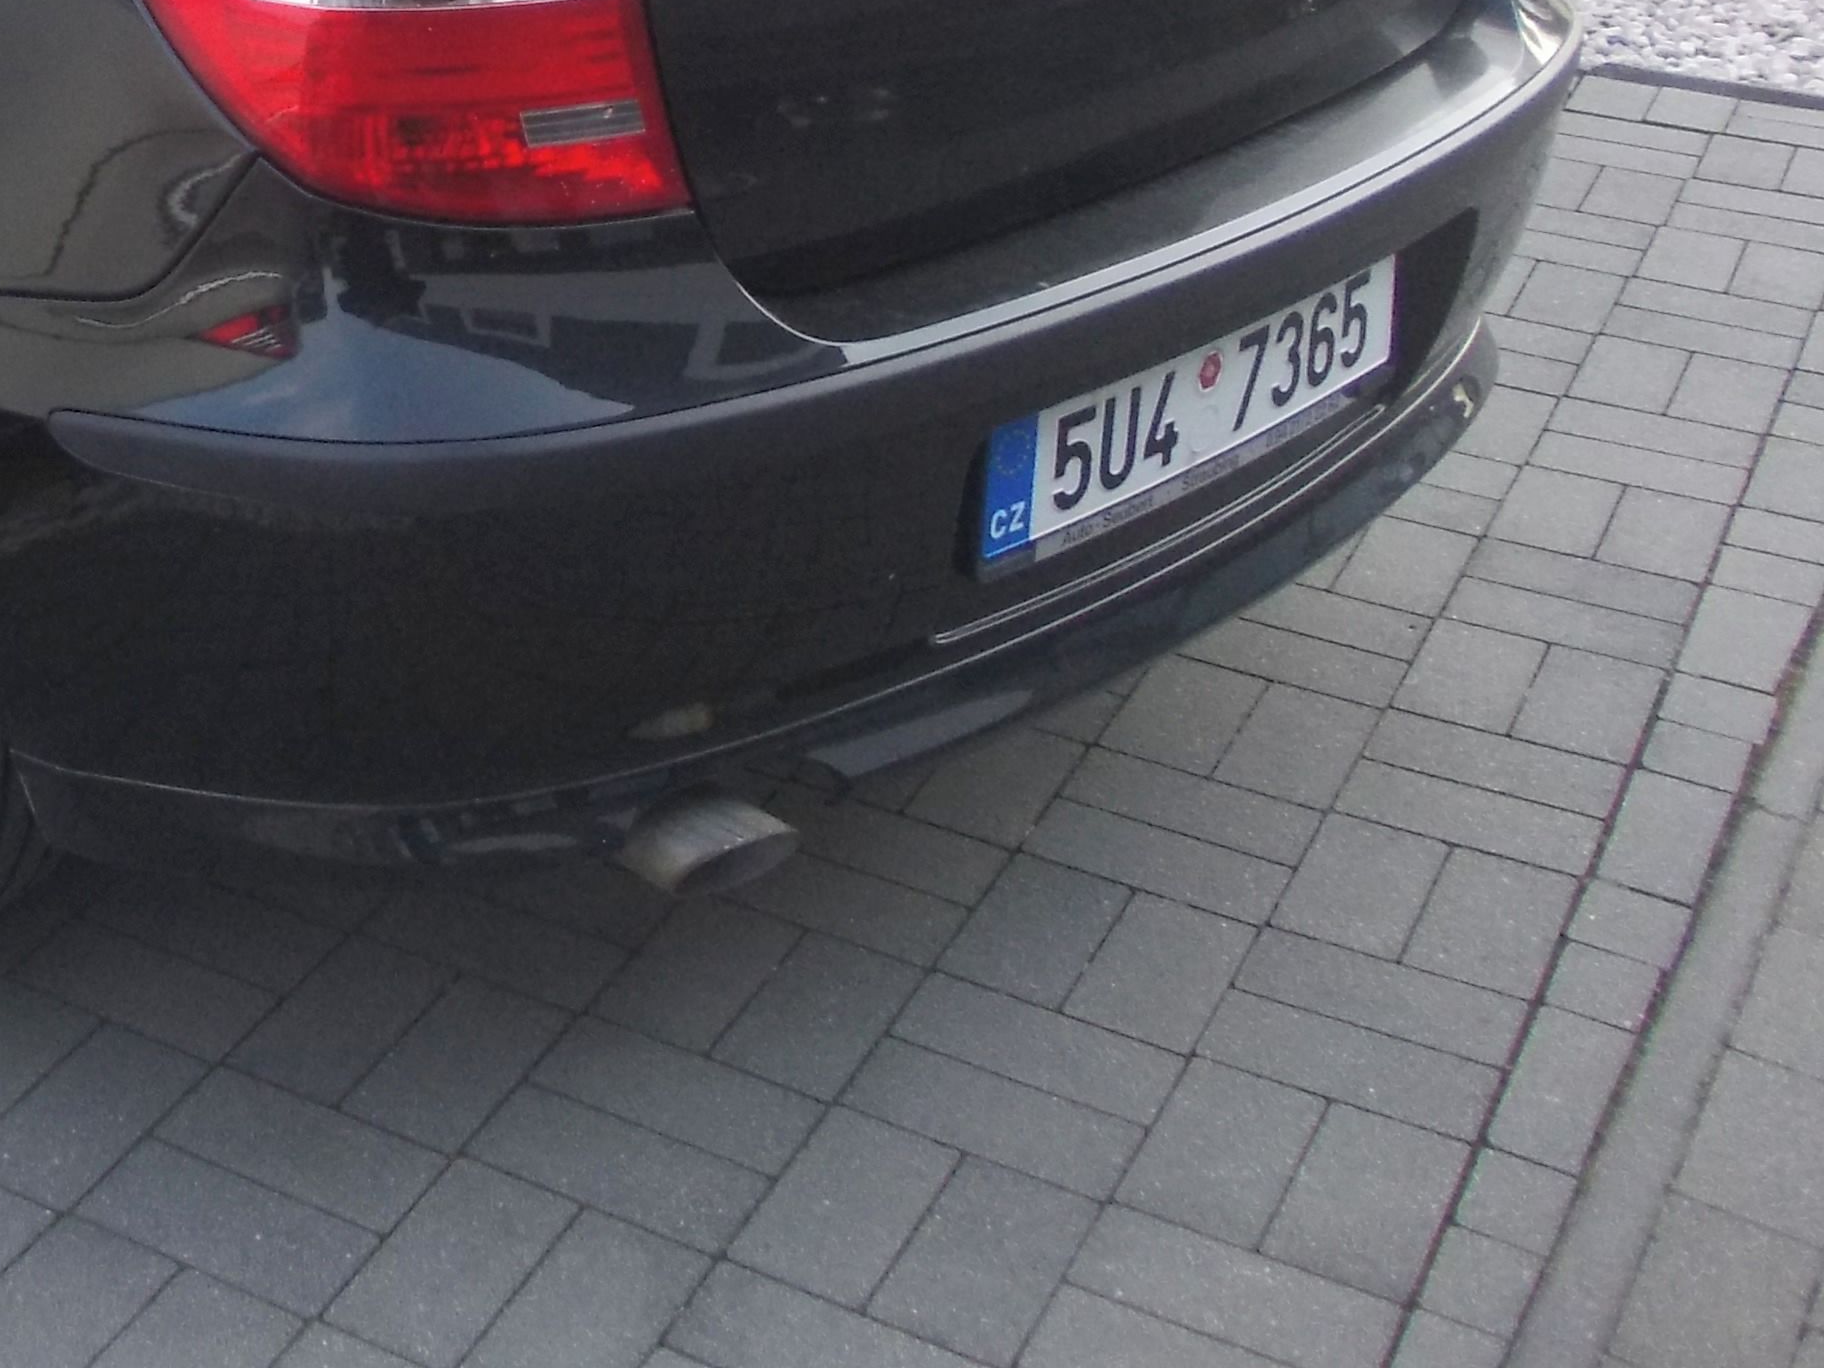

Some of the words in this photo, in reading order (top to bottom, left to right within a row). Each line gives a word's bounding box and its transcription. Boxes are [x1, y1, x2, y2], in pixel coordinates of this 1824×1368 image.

[1052, 370, 1180, 512] 5U4
[1232, 271, 1371, 432] 7365
[989, 500, 1026, 541] CZ
